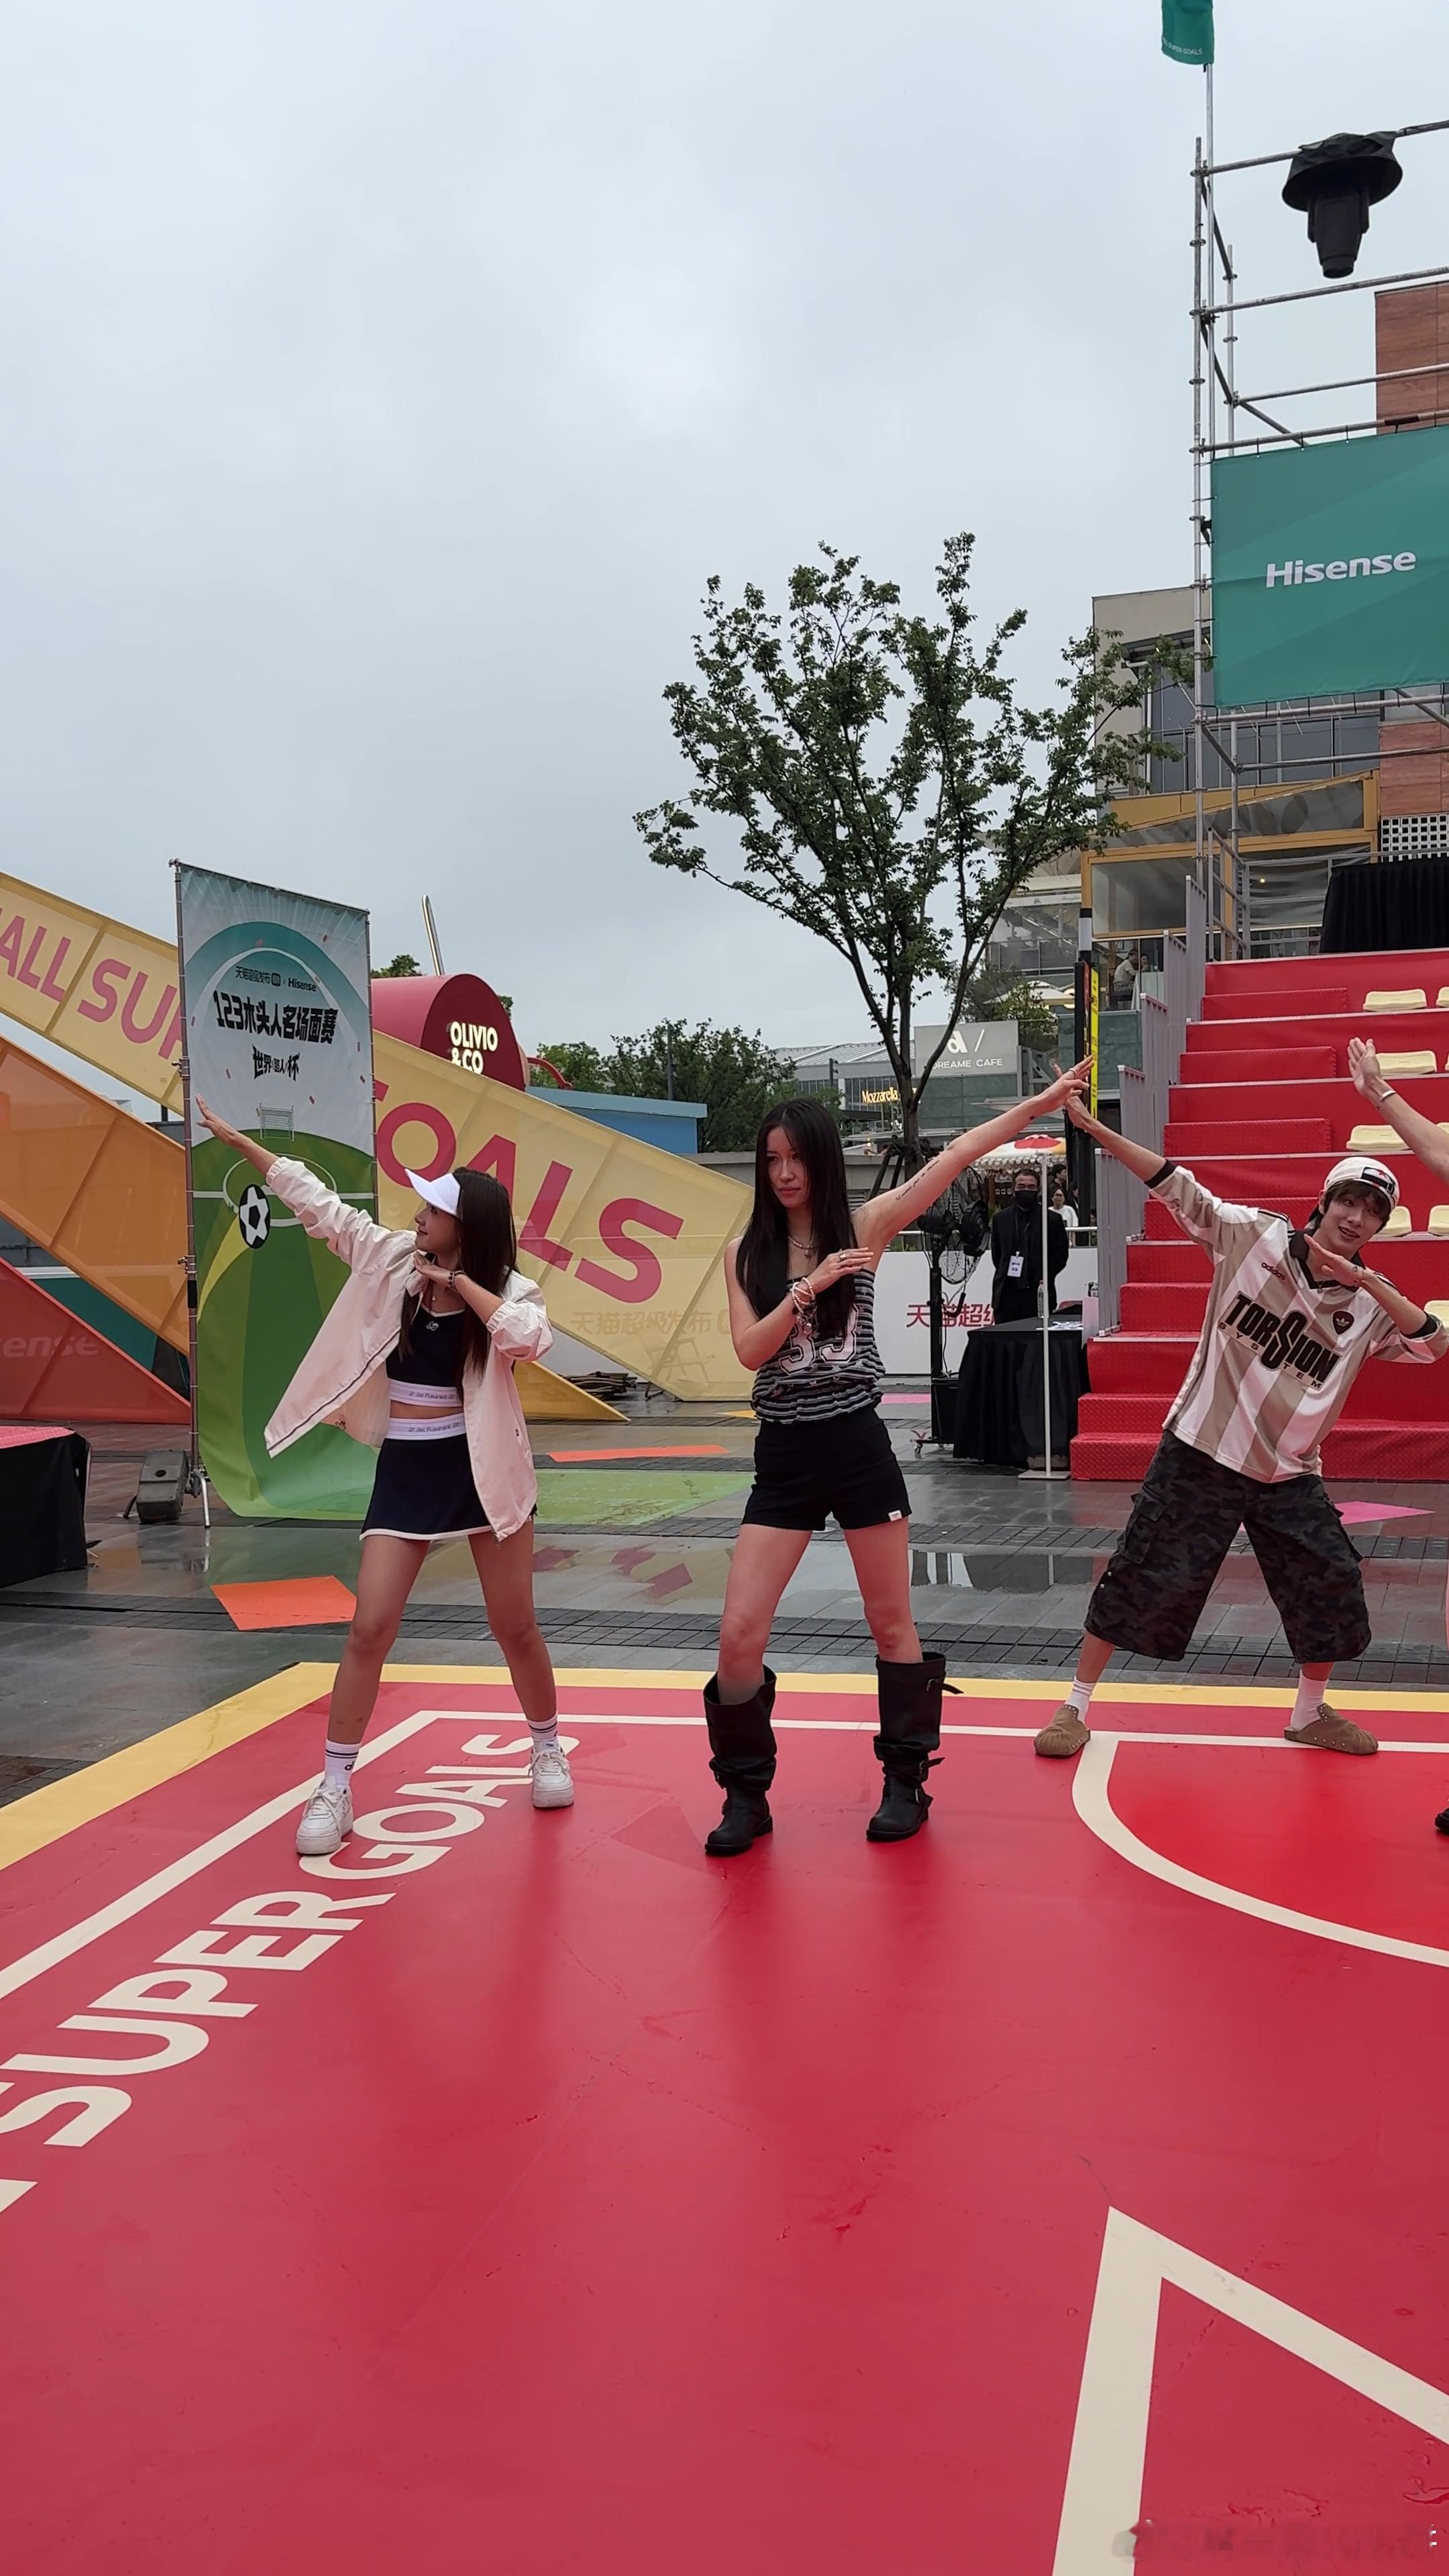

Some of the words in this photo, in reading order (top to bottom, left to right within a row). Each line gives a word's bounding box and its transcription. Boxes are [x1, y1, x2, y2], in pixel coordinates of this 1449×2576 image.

[1266, 552, 1416, 588] Hisense
[0, 908, 71, 1003] ALL
[288, 977, 317, 991] Hisense
[213, 990, 339, 1044] 123木头人名场面赛
[450, 1021, 498, 1052] OLIVIO
[451, 1047, 484, 1075] &CO
[976, 1058, 1004, 1067] CAFE
[862, 1086, 898, 1104] Mozzarella
[375, 1079, 684, 1303] OALS
[1261, 1263, 1286, 1281] adidas
[1225, 1293, 1340, 1383] TORSION
[299, 1733, 580, 1880] GOALS
[0, 1891, 396, 2147] SUPER
